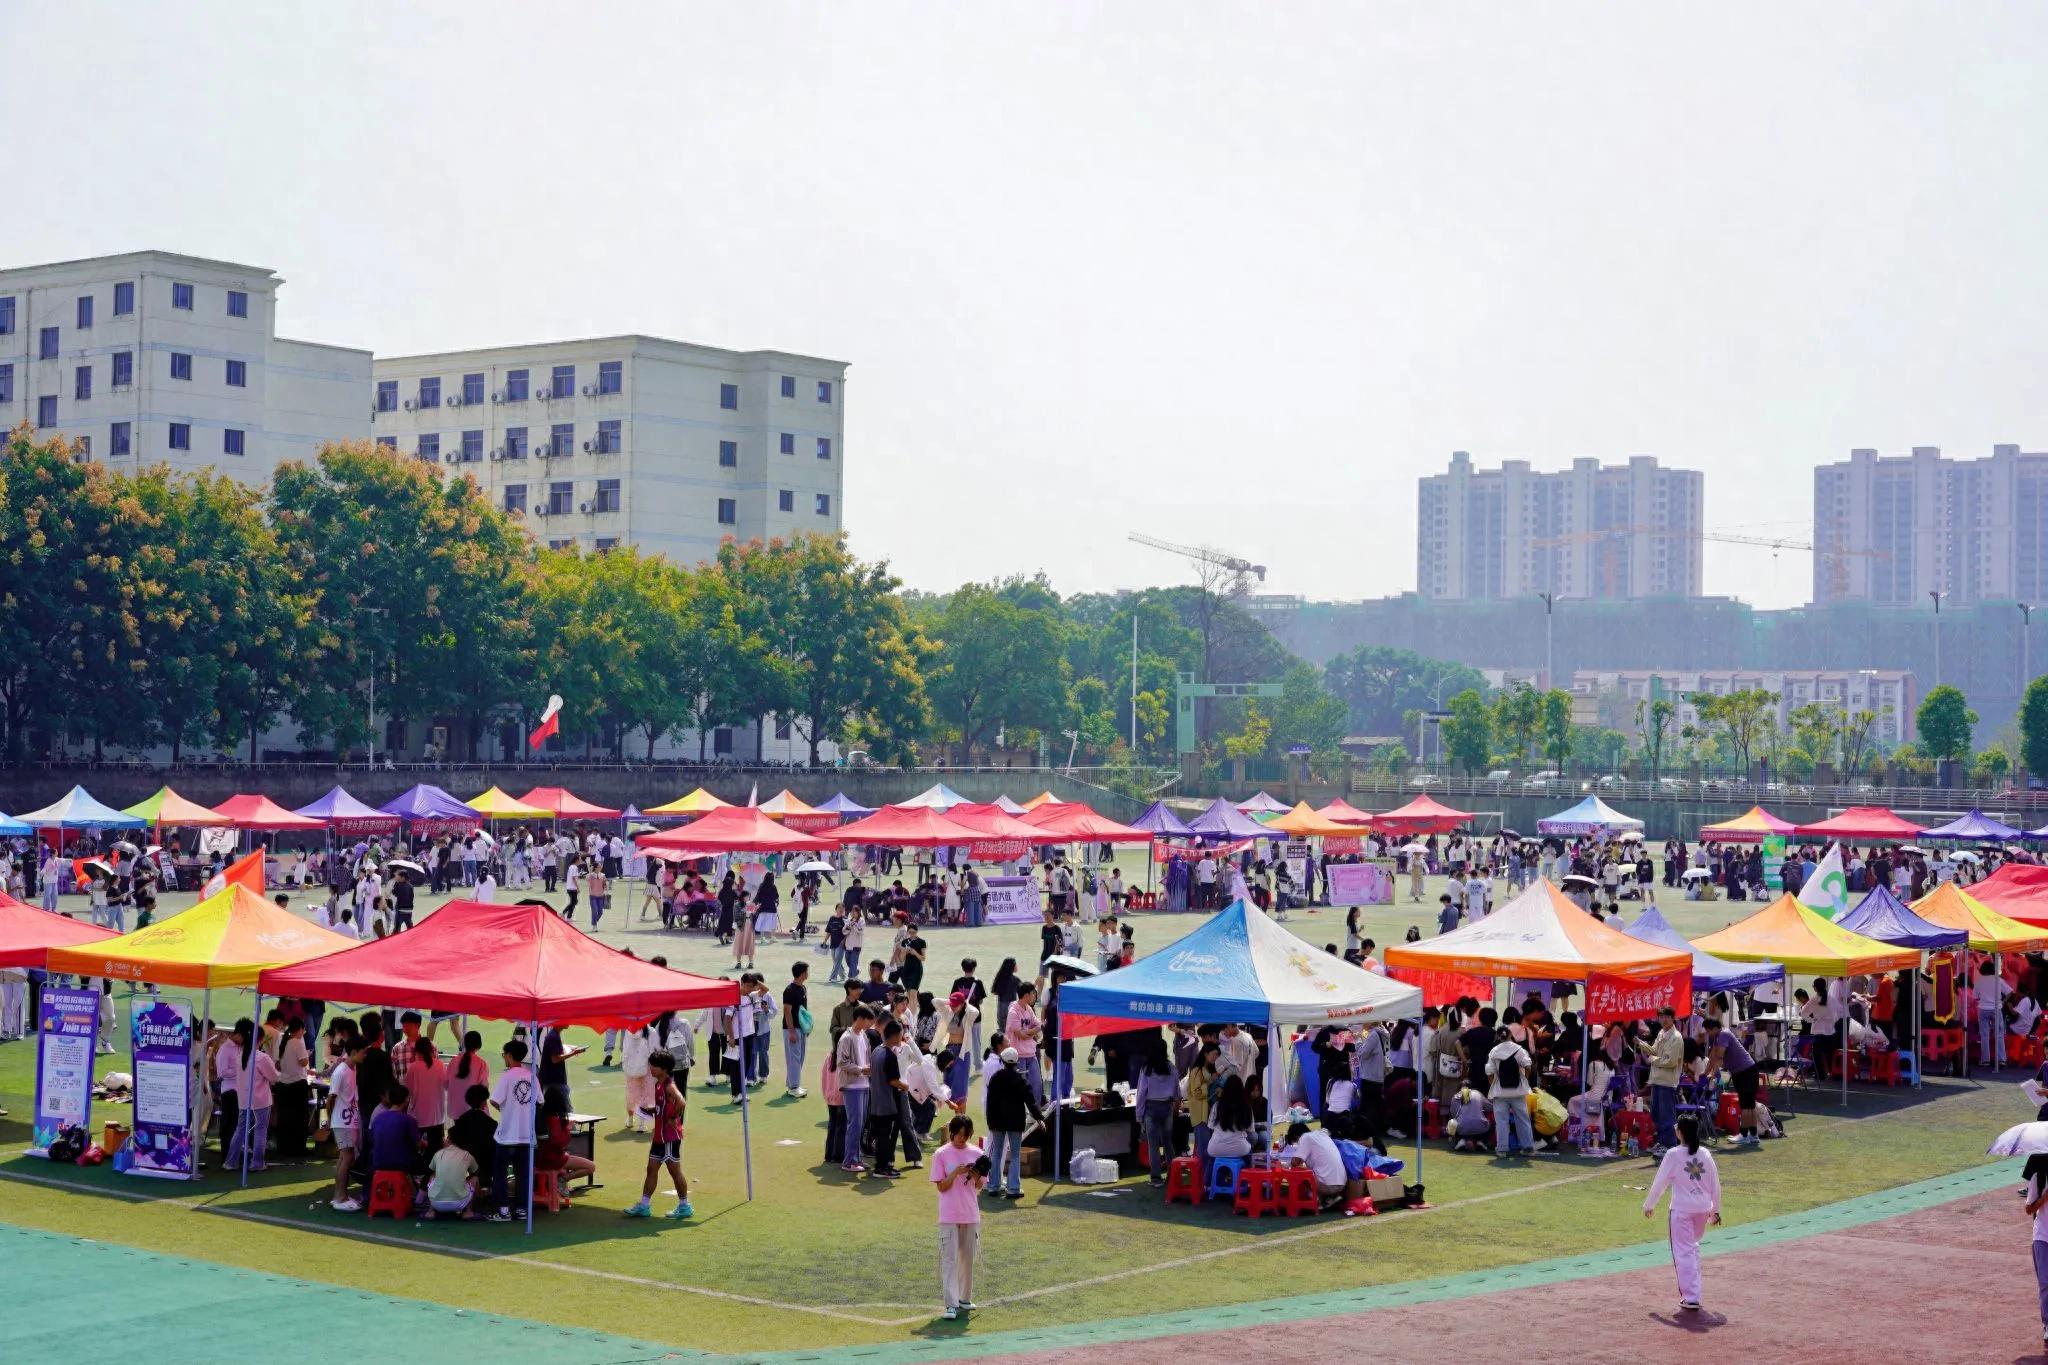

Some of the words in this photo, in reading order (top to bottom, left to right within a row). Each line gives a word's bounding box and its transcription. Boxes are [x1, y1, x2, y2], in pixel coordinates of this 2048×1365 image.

[138, 1024, 179, 1036] 计算机协会
